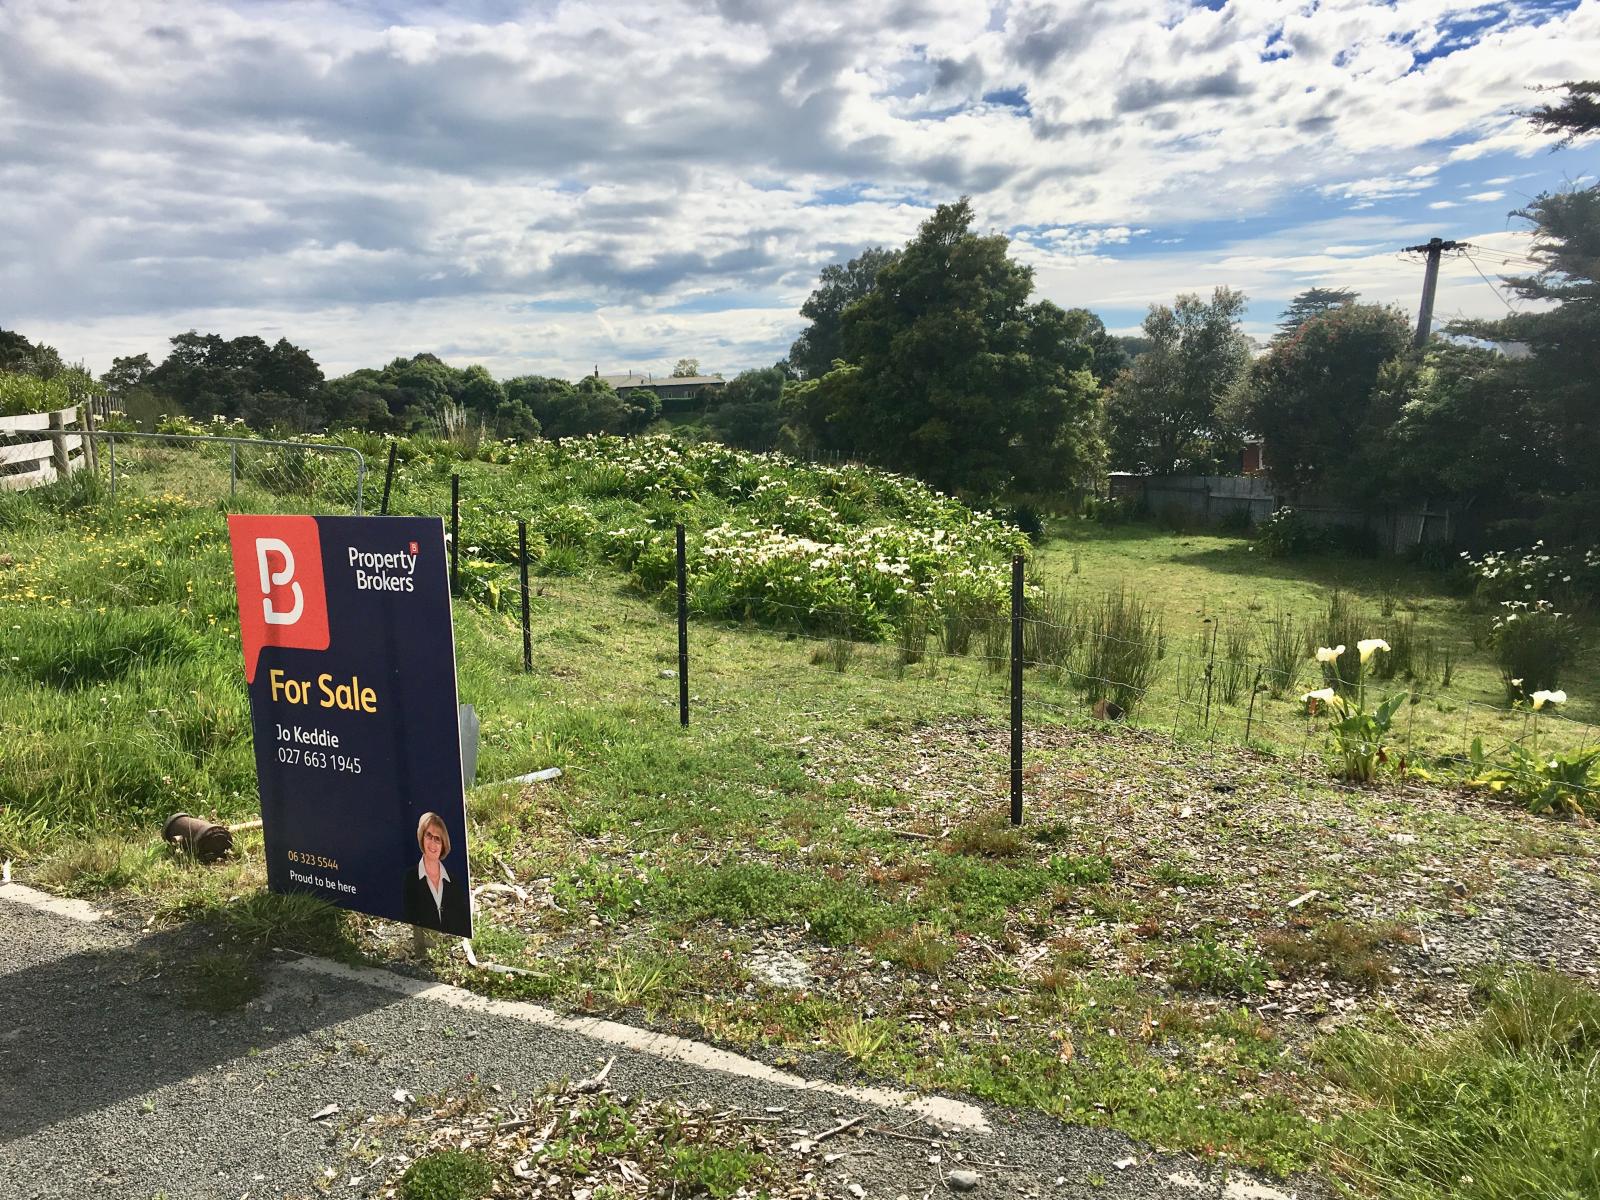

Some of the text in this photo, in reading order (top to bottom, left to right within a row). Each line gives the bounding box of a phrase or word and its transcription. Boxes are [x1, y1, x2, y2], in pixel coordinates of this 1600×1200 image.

[348, 546, 417, 575] Property
[356, 569, 414, 592] Brokers
[270, 669, 377, 713] For Sale
[276, 723, 339, 748] Jo Keddie
[278, 747, 361, 774] 027 663 1945
[288, 850, 339, 870] 06 323 5544
[289, 869, 357, 894] Proud to be here
